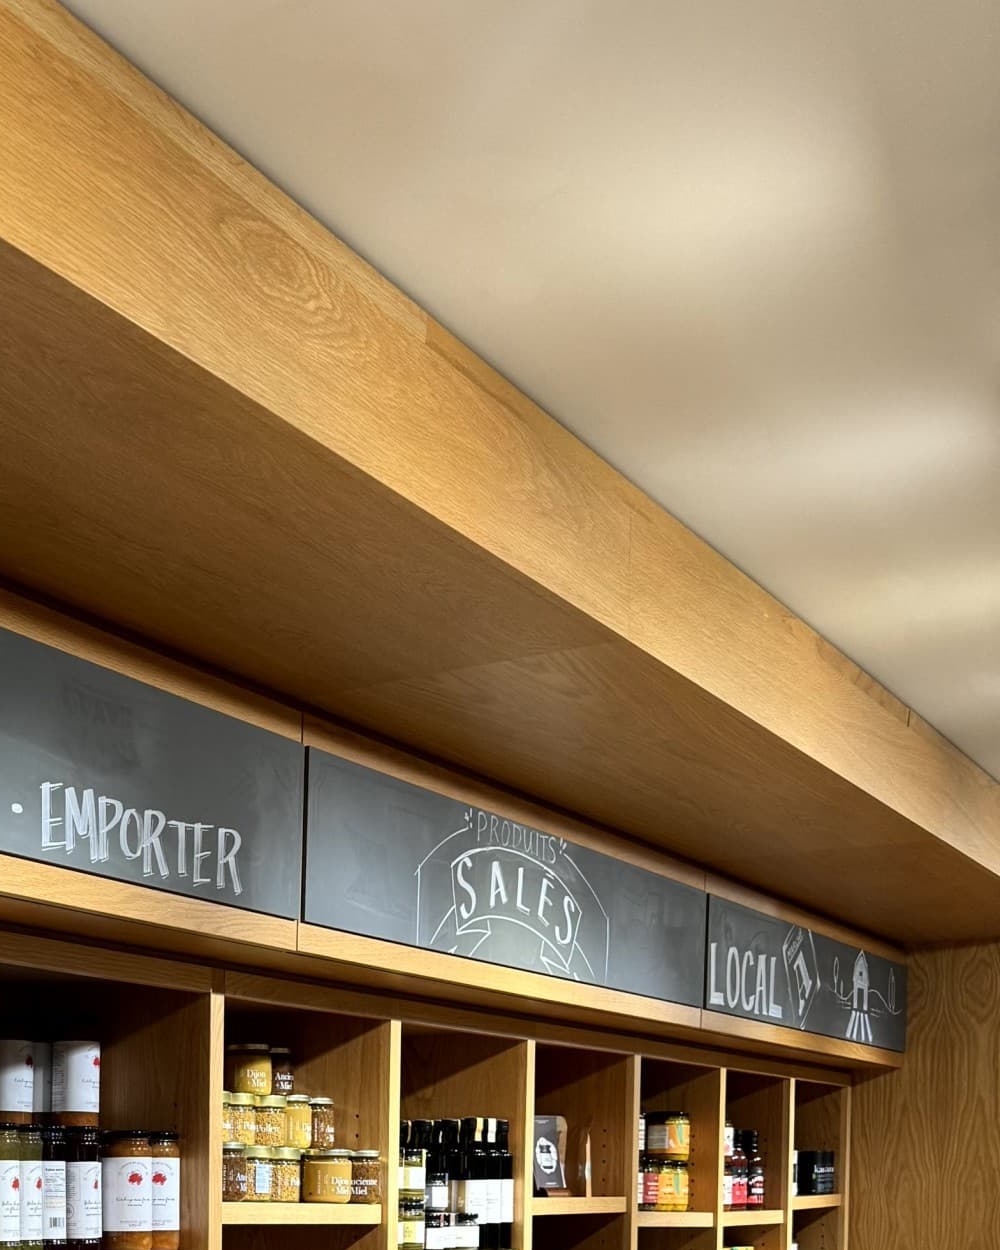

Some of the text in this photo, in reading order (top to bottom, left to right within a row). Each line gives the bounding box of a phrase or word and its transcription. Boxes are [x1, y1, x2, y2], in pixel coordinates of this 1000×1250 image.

[39, 781, 244, 897] EMPORTER
[476, 811, 557, 865] PRODUITS
[709, 942, 783, 1019] LOCAL
[247, 1069, 266, 1079] Dijon
[252, 1079, 267, 1088] Miel
